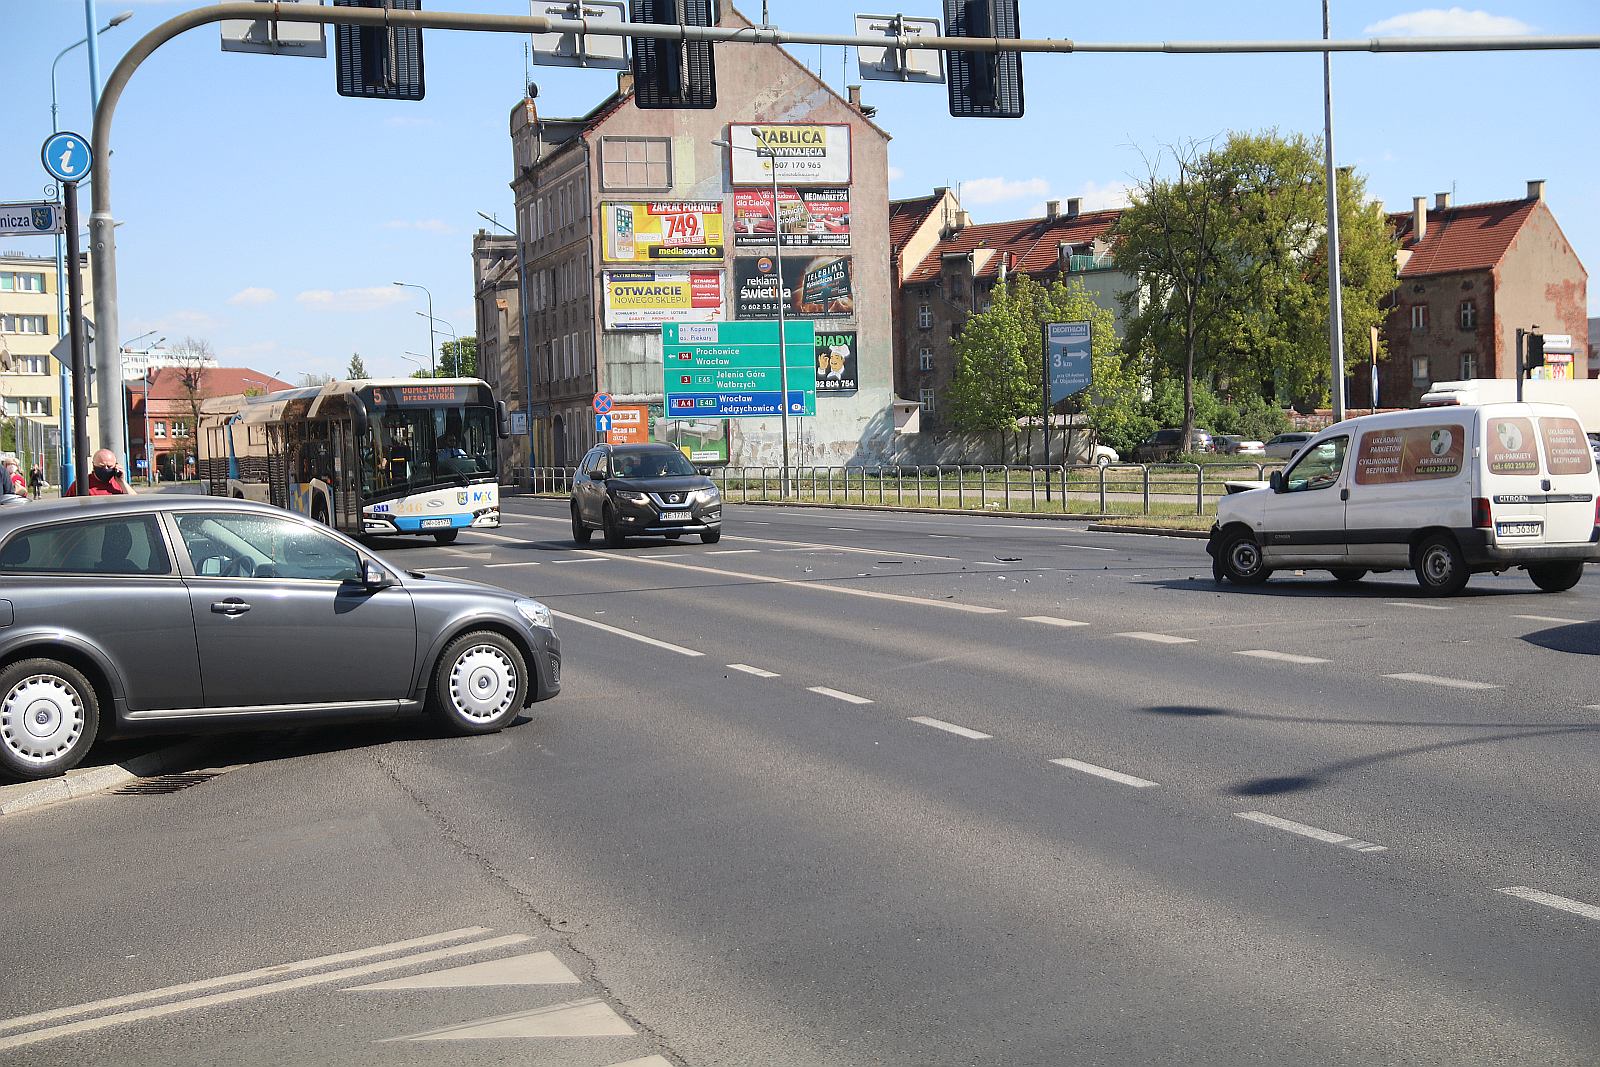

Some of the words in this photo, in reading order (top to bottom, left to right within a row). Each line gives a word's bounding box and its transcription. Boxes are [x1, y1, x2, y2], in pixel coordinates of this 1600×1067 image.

[0, 215, 29, 227] nicza
[659, 247, 708, 257] mediaexpert
[615, 287, 682, 295] OTWARCIE
[816, 336, 852, 346] BIADY
[1054, 354, 1062, 367] 3
[746, 370, 765, 378] Góra
[717, 381, 756, 389] Wałbrzych
[374, 388, 381, 403] 5
[720, 404, 774, 413] Jędrzychowice
[397, 503, 422, 512] 246
[1502, 525, 1513, 534] DL
